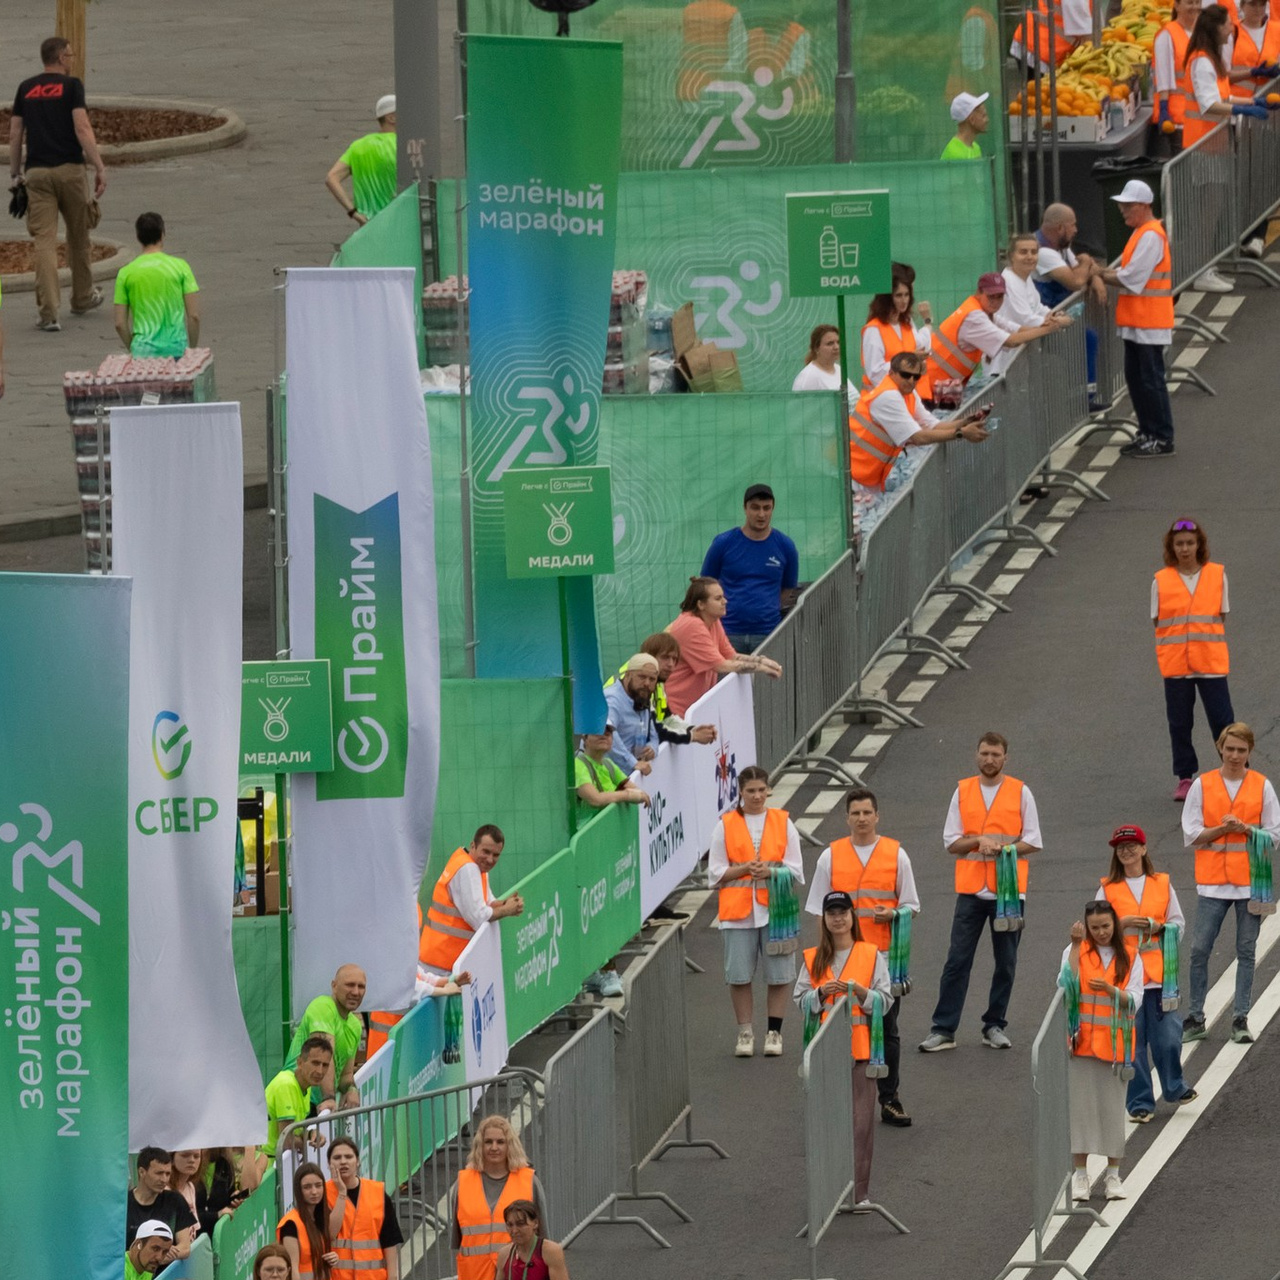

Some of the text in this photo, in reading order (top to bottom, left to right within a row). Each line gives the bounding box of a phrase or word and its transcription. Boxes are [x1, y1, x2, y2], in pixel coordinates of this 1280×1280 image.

[479, 178, 604, 210] зелёный
[479, 206, 604, 237] марафон
[820, 275, 861, 288] ВОДА
[528, 554, 594, 569] МЕДАЛИ
[339, 537, 384, 702] Прайм
[242, 676, 261, 686] егче
[279, 674, 305, 686] Прайм
[243, 750, 311, 767] МЕДАЛИ
[135, 796, 219, 836] СБЕР
[649, 811, 685, 877] КУЛЬТУРА
[1, 907, 44, 1109] зелёный
[44, 927, 92, 1137] марафон
